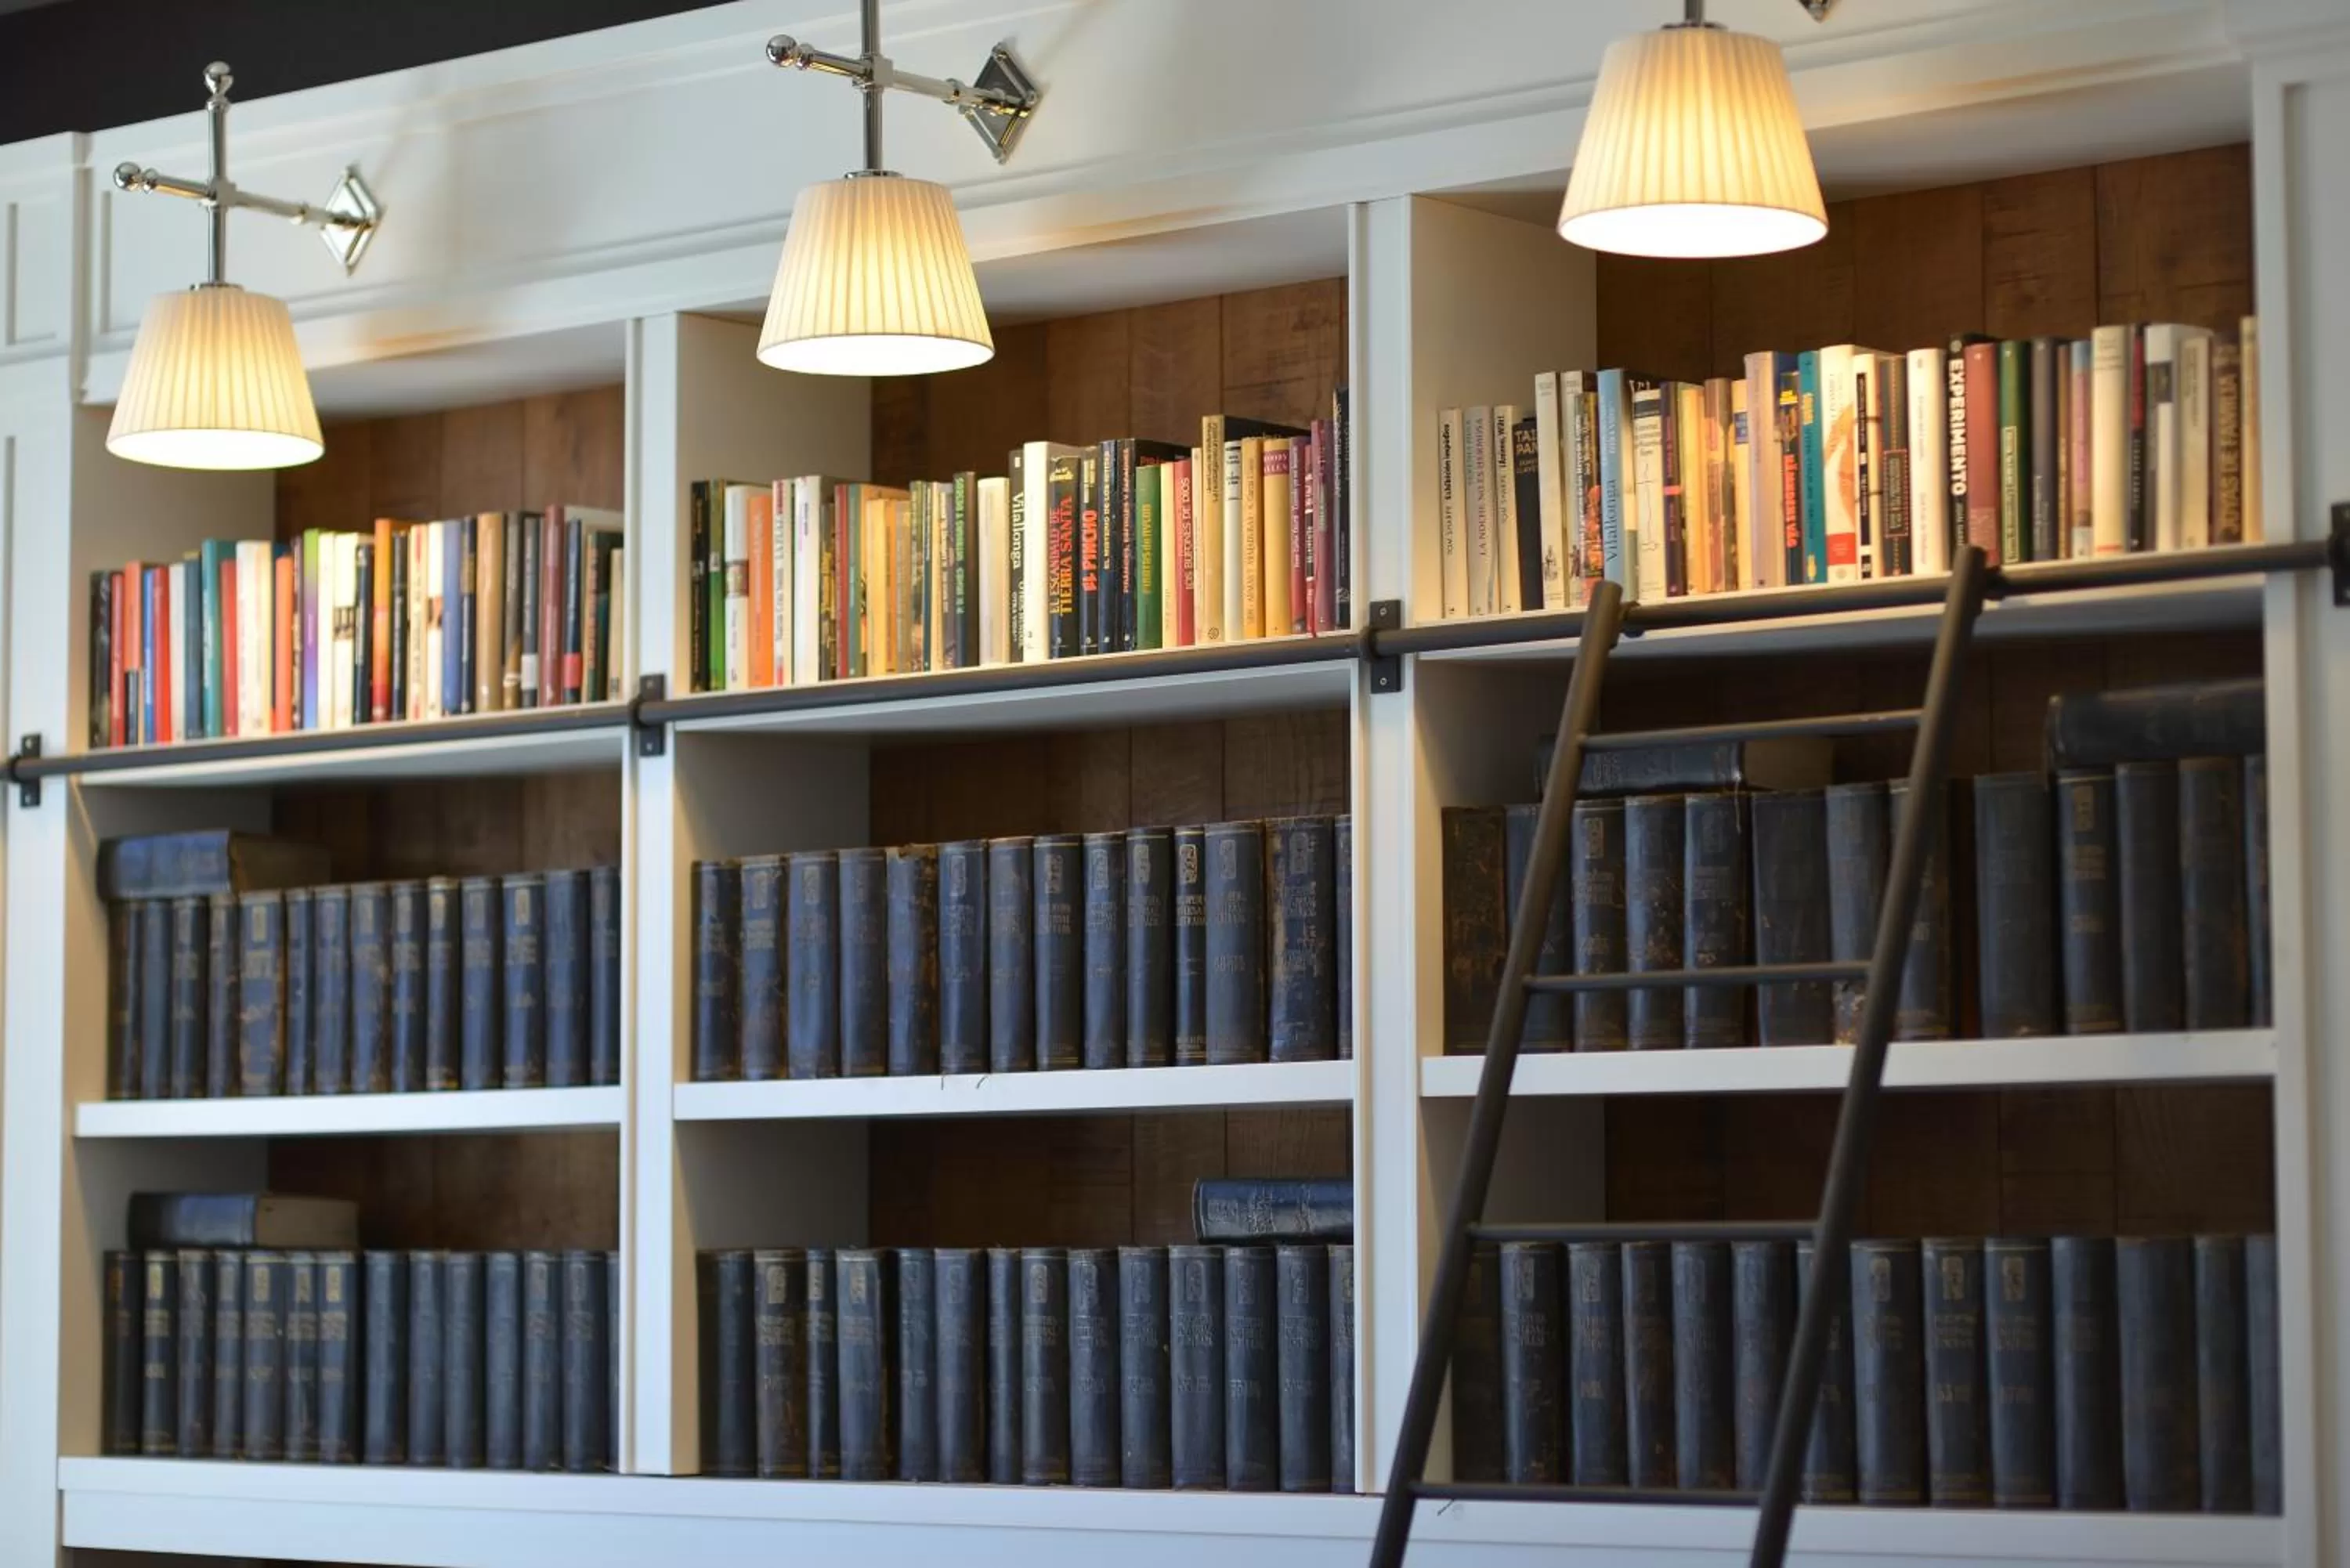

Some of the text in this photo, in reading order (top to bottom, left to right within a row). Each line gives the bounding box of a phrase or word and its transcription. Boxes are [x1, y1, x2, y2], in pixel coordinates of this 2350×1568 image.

[1948, 358, 1968, 496] EXPERIMENTO
[1180, 477, 1190, 503] DIOS
[1010, 491, 1025, 570] Vilallonga
[1049, 507, 1060, 525] DE
[1181, 504, 1191, 520] DE
[1603, 479, 1619, 562] Vilallonga
[1060, 495, 1073, 616] TIERRA SANTA
[1082, 510, 1097, 571] PINCHO
[1182, 521, 1193, 569] BUFONES
[1104, 557, 1111, 569] EL
[1082, 573, 1098, 592] EL
[1050, 598, 1060, 613] EL
